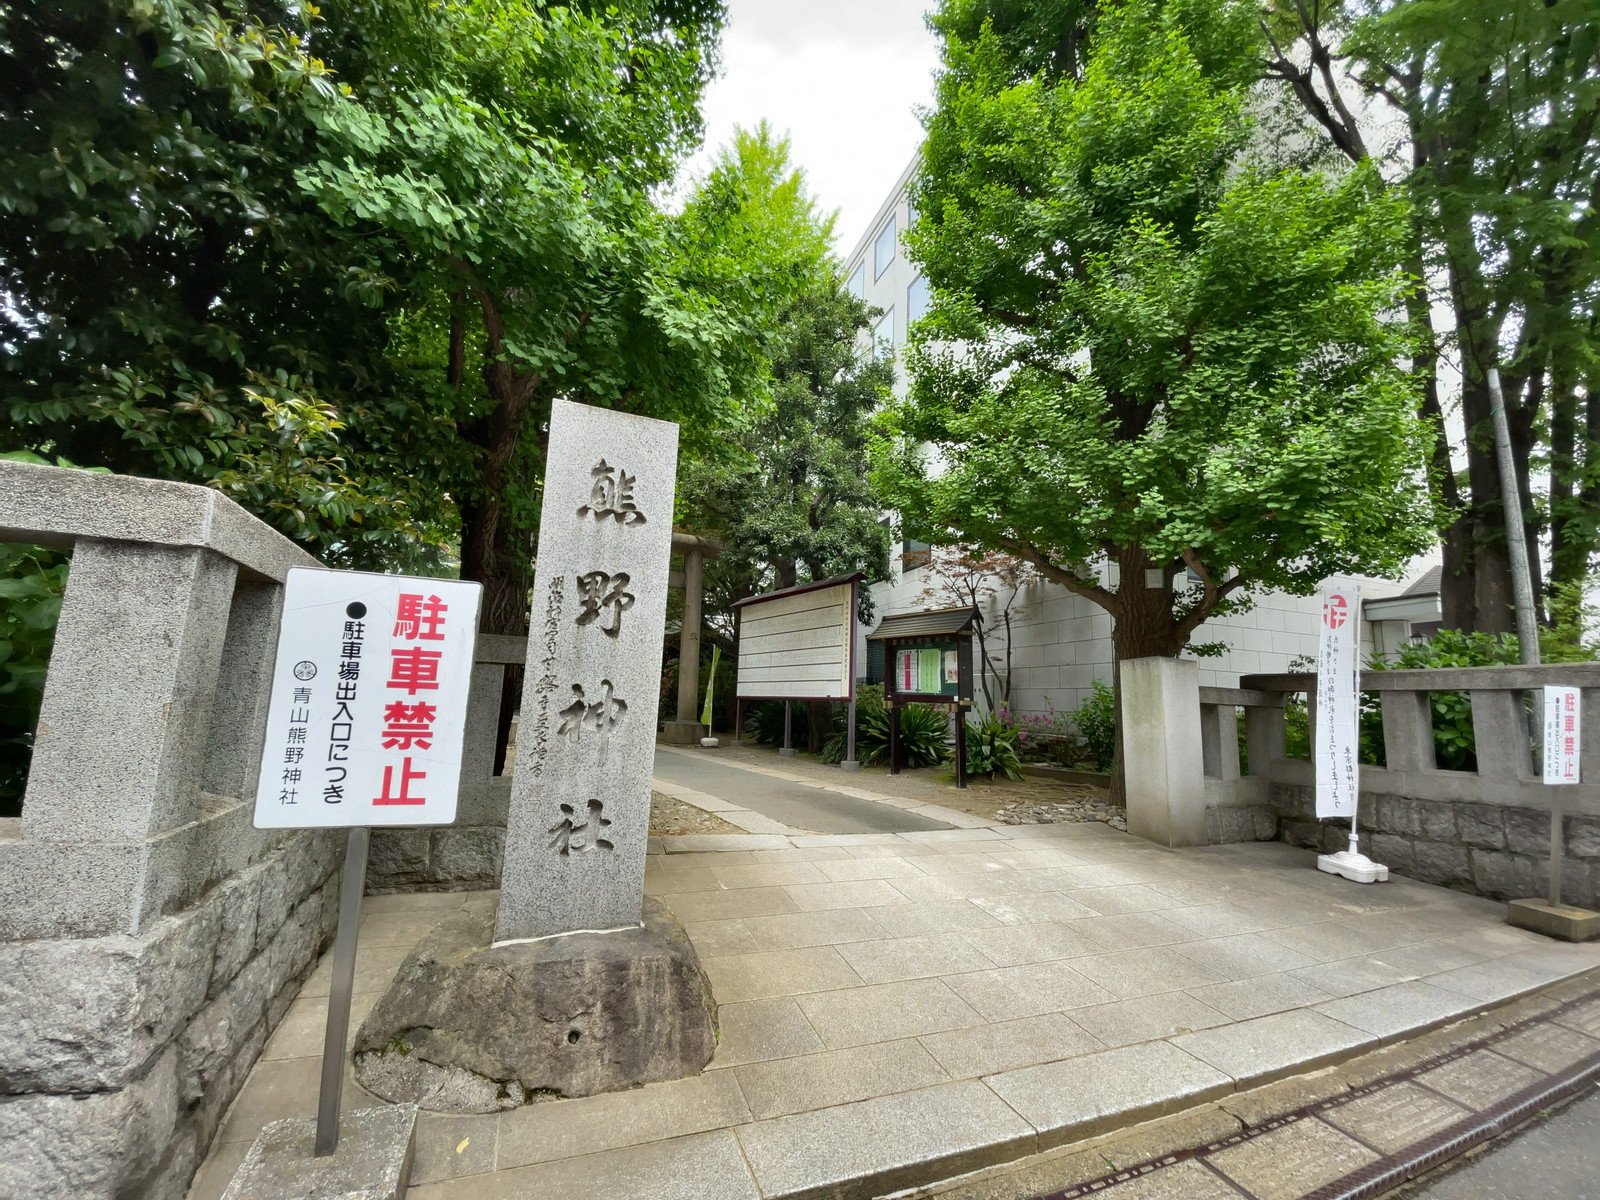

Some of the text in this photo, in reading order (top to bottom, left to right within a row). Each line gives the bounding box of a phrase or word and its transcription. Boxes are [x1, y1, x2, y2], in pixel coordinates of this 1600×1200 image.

[278, 687, 312, 806] 青山熊野神社
[322, 620, 366, 804] 駐車場出入口につき
[372, 593, 448, 806] 駐車禁止
[548, 457, 647, 857] 熊野神社
[1563, 693, 1575, 778] 駐車禁止
